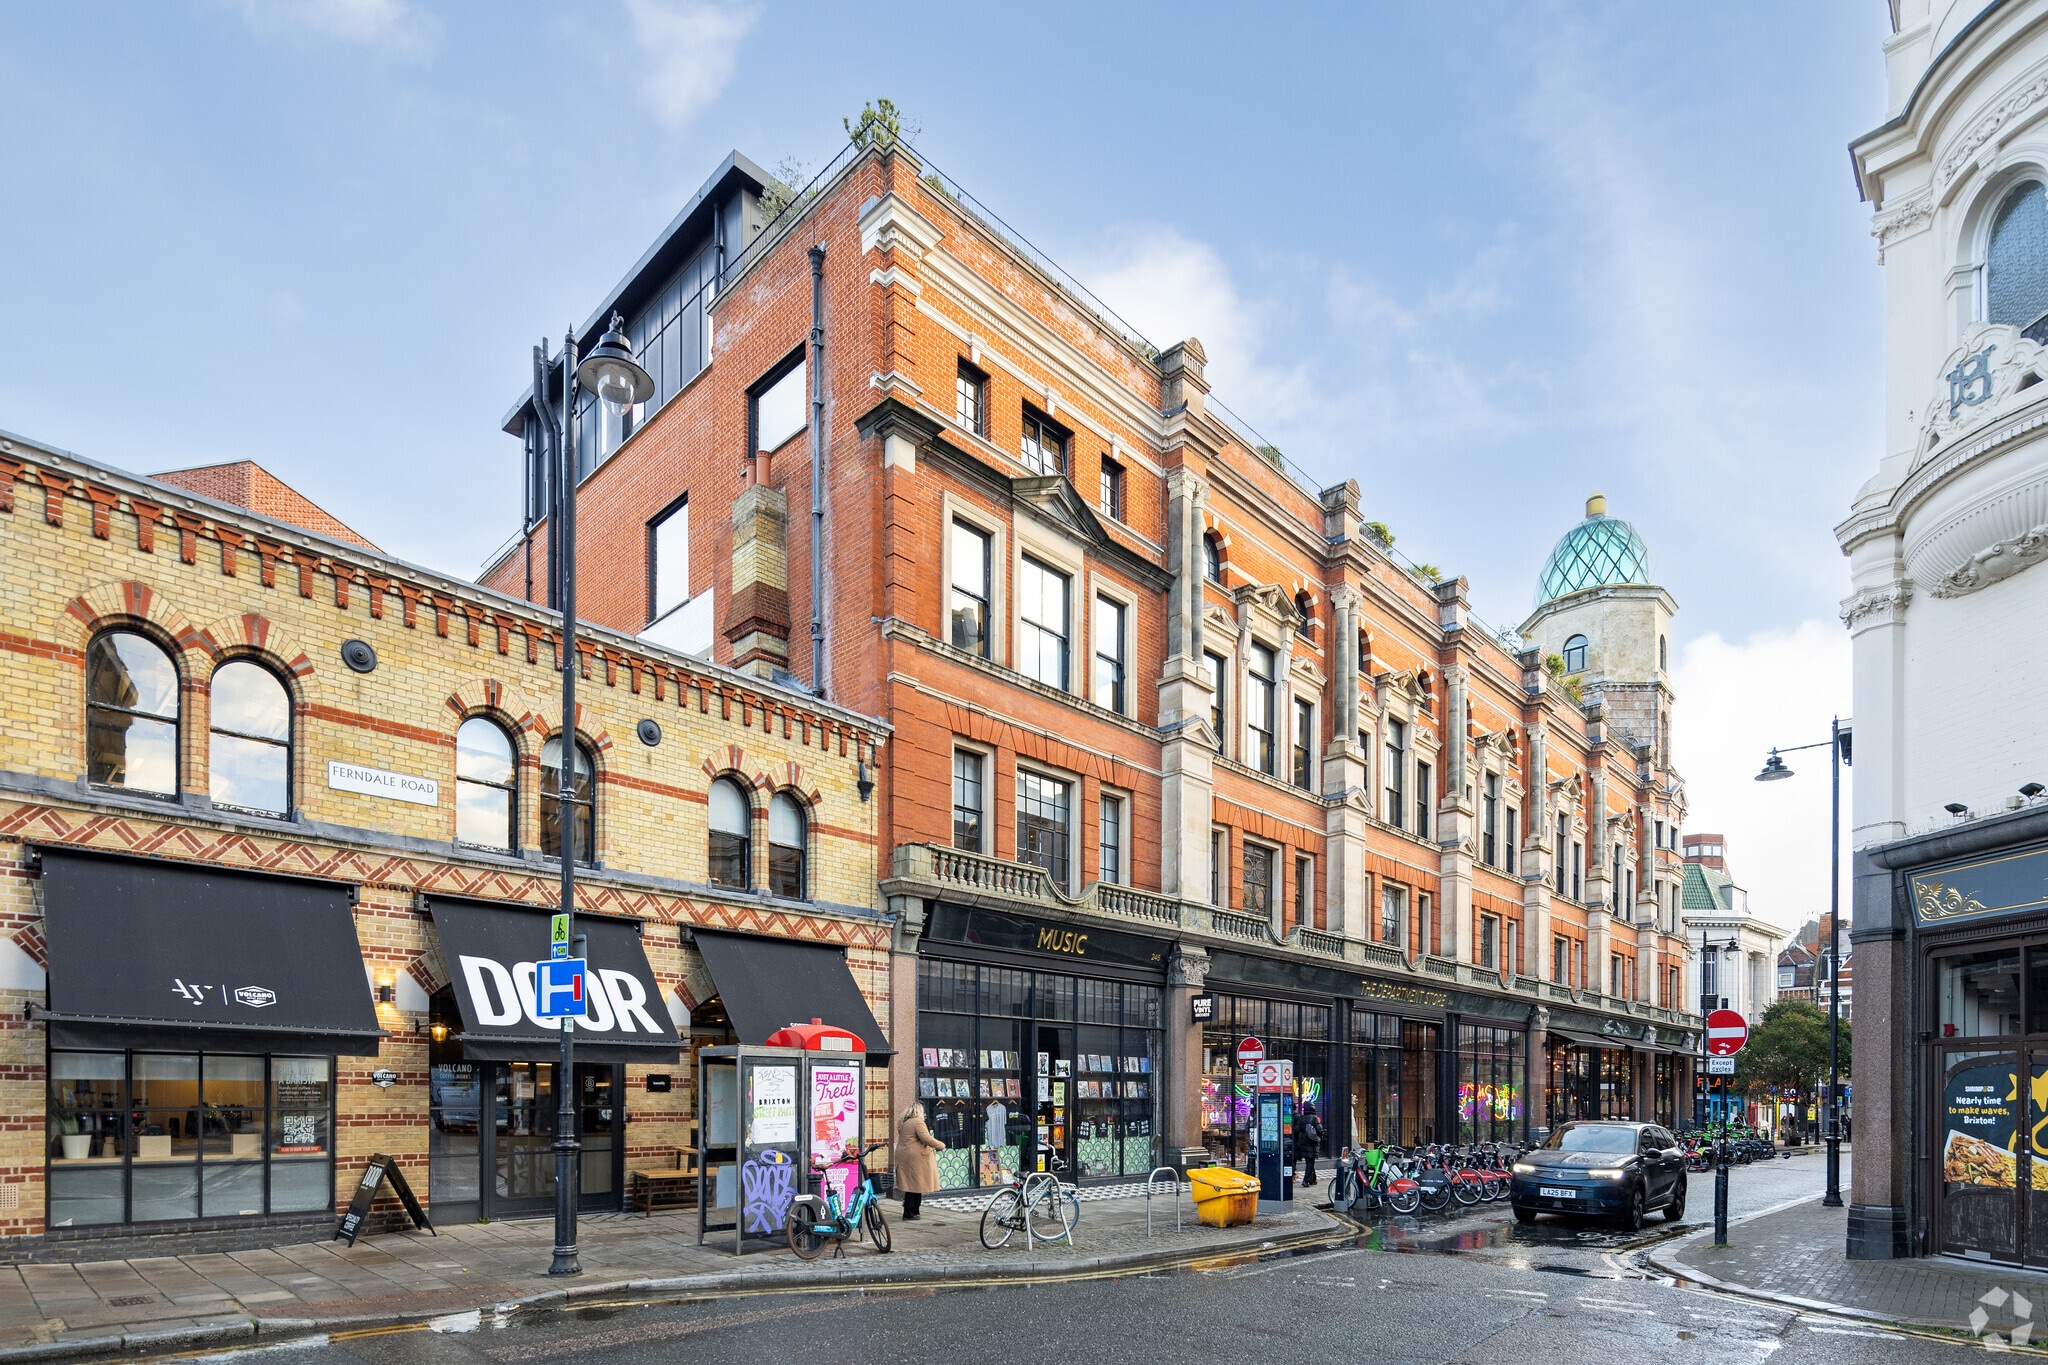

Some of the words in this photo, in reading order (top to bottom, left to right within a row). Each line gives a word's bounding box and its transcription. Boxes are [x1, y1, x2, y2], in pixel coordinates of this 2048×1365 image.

[333, 766, 396, 787] FERNDALE
[401, 778, 434, 793] ROAD
[1037, 927, 1088, 955] MUSIC
[239, 991, 273, 999] VOLCANO
[458, 954, 665, 1034] DOOR
[1360, 980, 1377, 997] THE
[1376, 982, 1425, 1004] DEPARTMENT
[1424, 991, 1447, 1007] STORE
[1193, 998, 1212, 1008] PURE
[438, 1063, 472, 1073] VOLCANO
[1711, 1059, 1733, 1067] Except
[815, 1076, 856, 1101] Treat
[1955, 1096, 1982, 1106] Nearly
[1983, 1096, 2002, 1105] time
[1948, 1106, 1957, 1114] to
[1958, 1106, 1980, 1115] make
[1981, 1108, 2010, 1116] waves,
[1963, 1115, 1996, 1125] Brixton!
[1542, 1188, 1559, 1196] LA25
